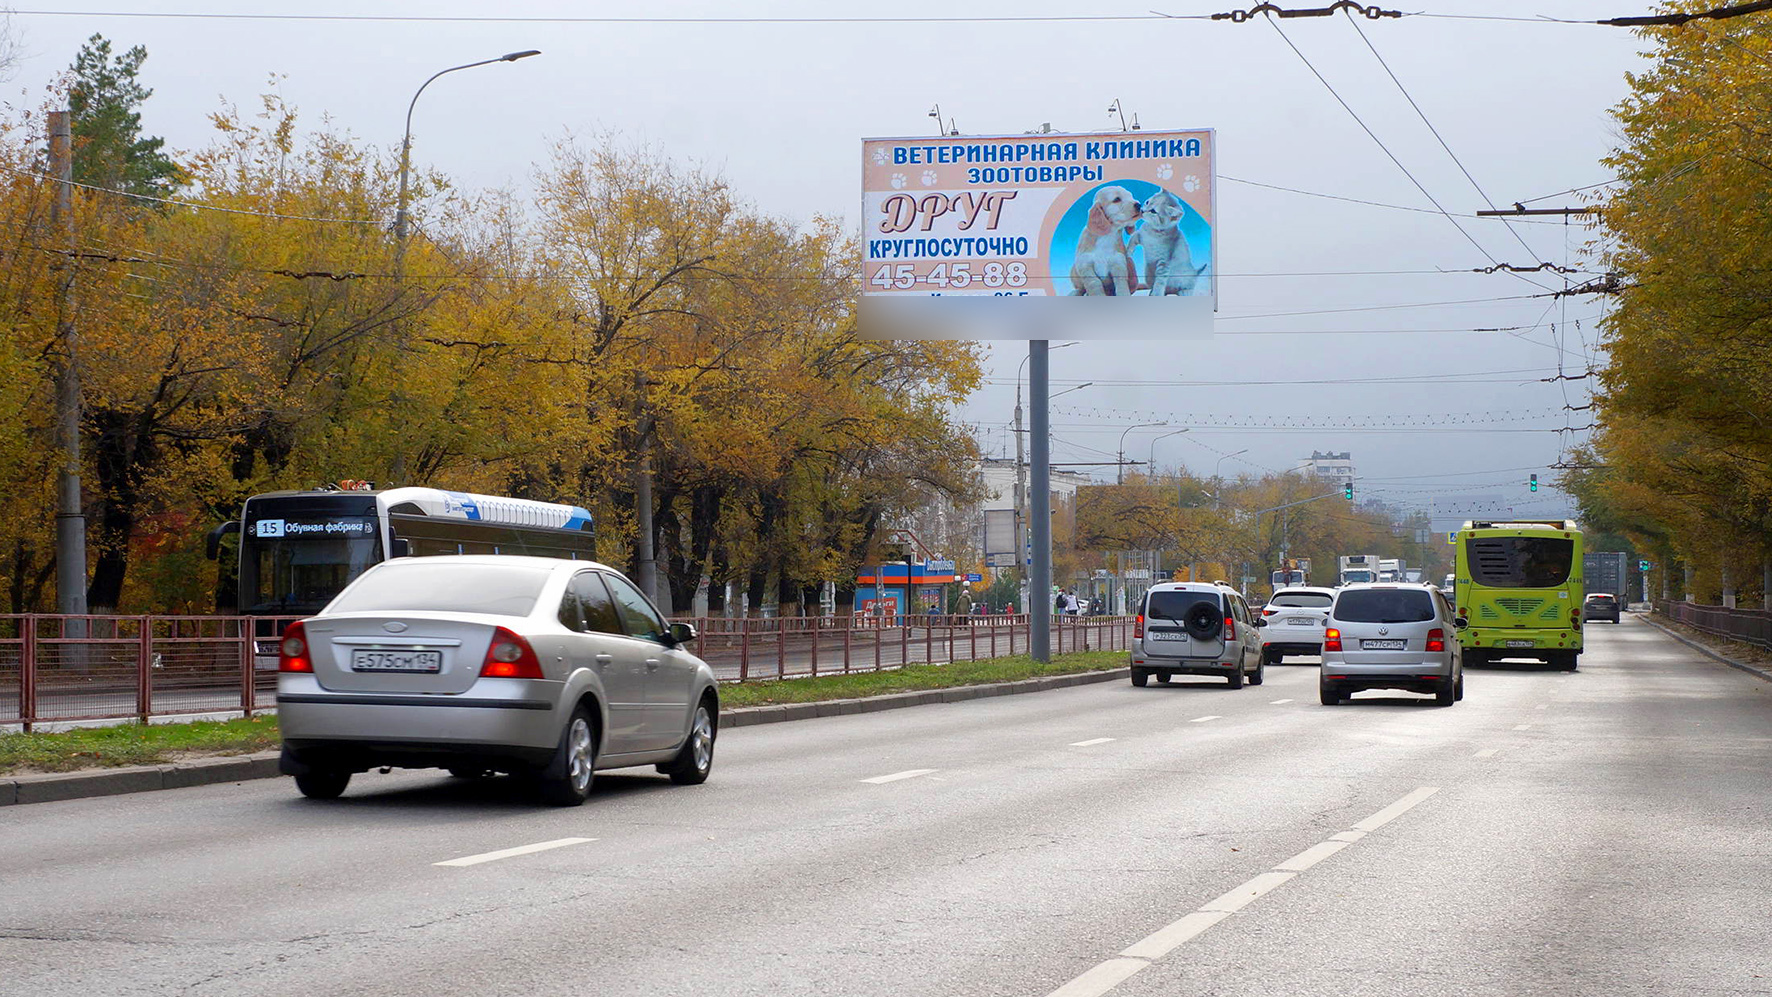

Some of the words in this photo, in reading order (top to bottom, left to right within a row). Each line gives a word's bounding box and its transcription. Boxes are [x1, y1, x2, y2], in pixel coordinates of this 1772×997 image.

[893, 142, 1078, 165] ВЕТЕРИНАРНАЯ
[1085, 138, 1201, 160] КЛИНИКА
[967, 164, 1103, 184] ЗООТОВАРЫ
[878, 190, 1018, 234] ДРУГ
[869, 236, 1029, 259] КРУГЛОСУТОЧНО
[871, 261, 1028, 289] 45-45-88
[262, 522, 278, 534] 15
[285, 522, 324, 534] Обувная
[325, 521, 363, 533] фабрика
